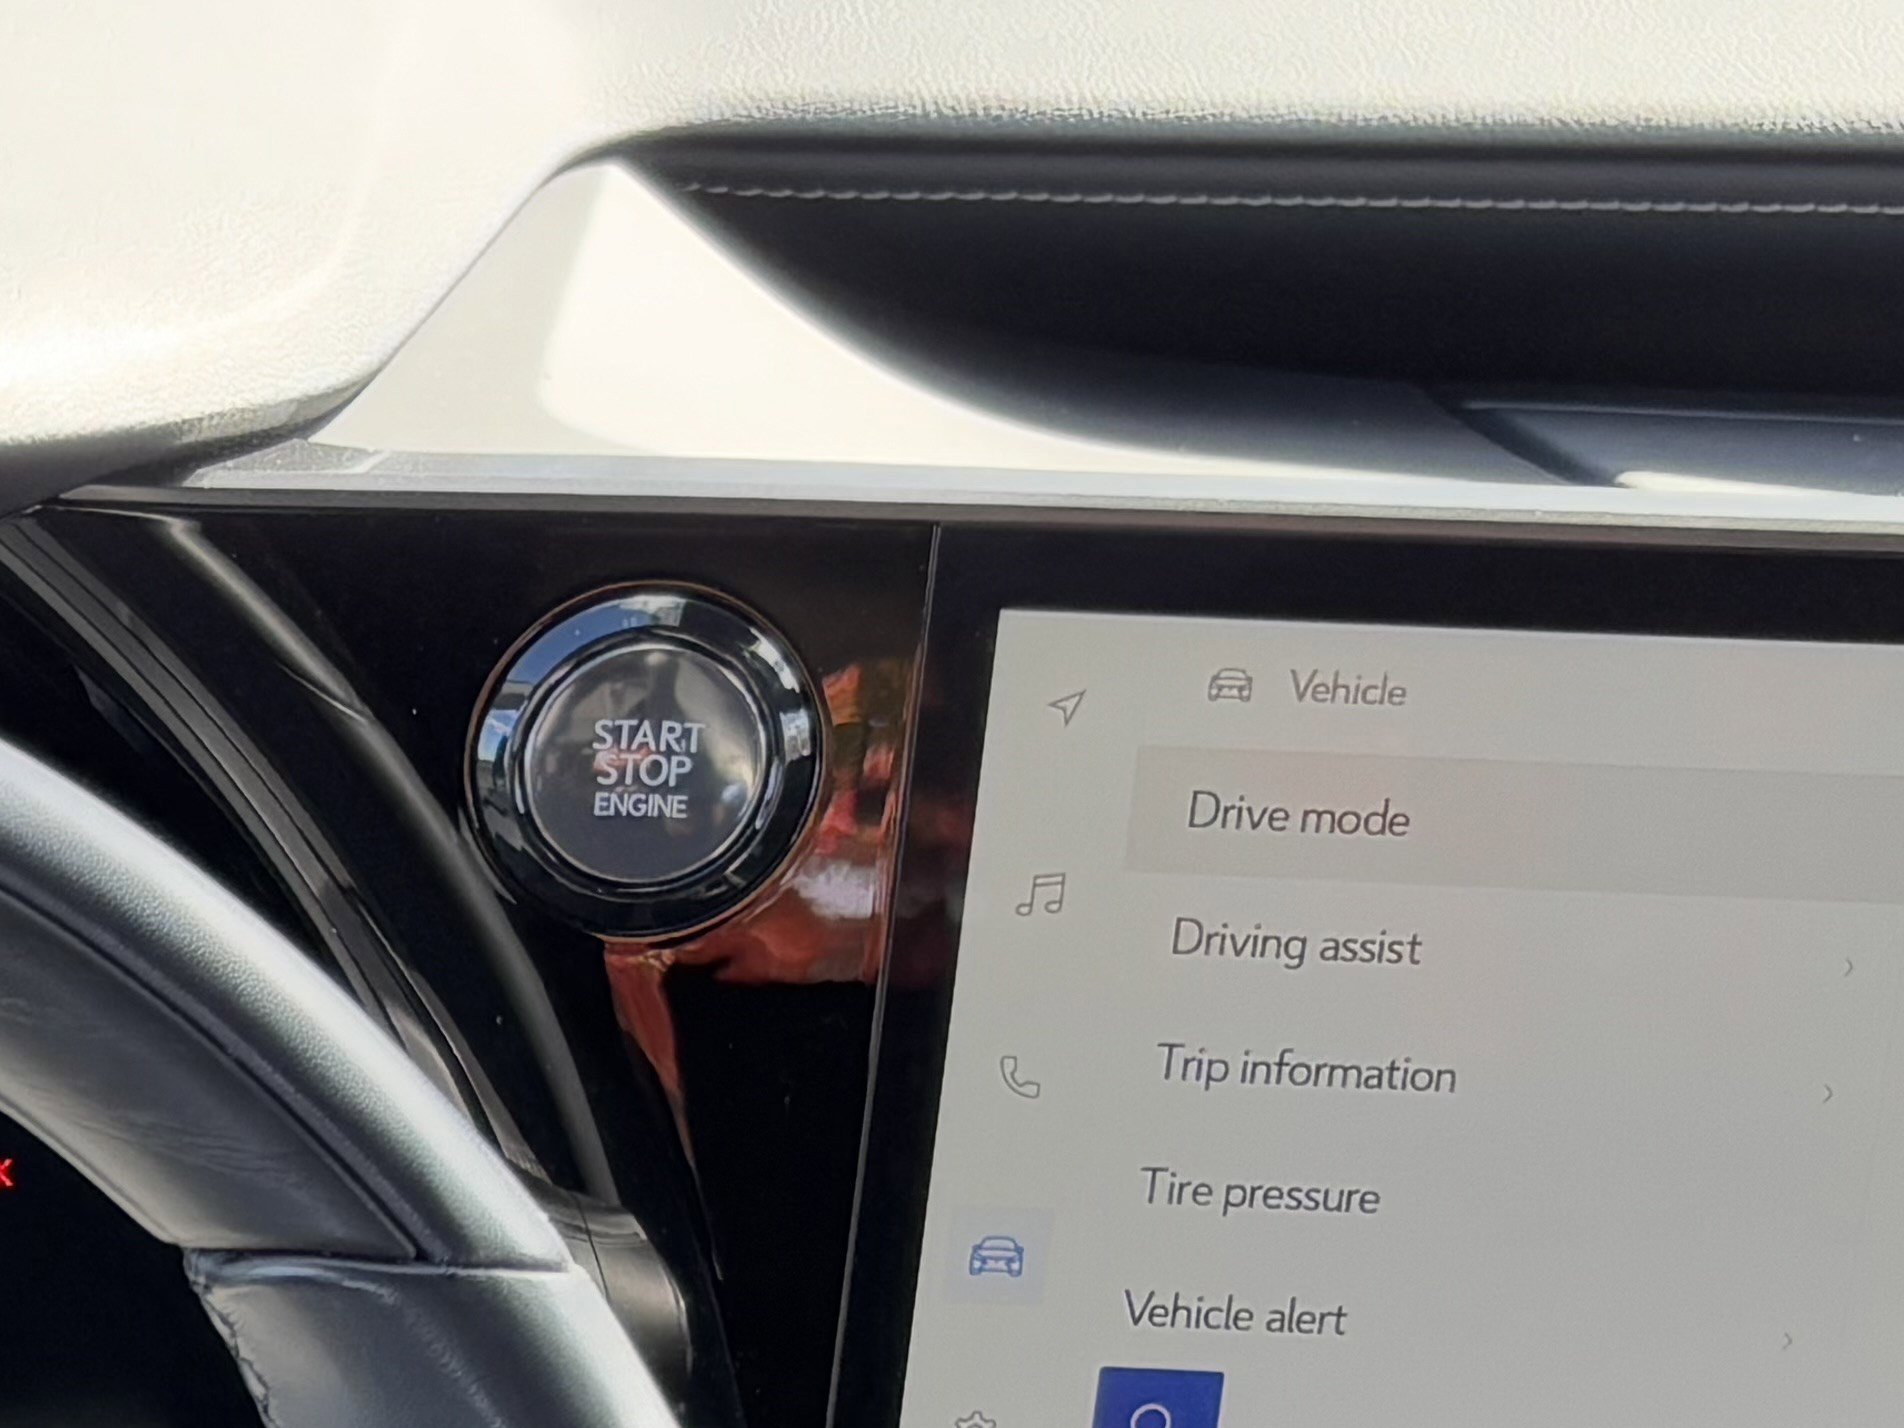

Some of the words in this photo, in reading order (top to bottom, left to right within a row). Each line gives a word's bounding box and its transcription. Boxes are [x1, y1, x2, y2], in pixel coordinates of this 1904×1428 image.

[1290, 668, 1407, 707] Vehicle
[593, 719, 705, 754] START
[595, 755, 693, 787] STOP
[593, 793, 689, 819] ENGINE
[1188, 790, 1290, 832] Drive
[1300, 797, 1411, 837] mode
[1172, 916, 1308, 970] Driving
[1319, 929, 1423, 966] assist
[1157, 1042, 1230, 1092] Trip
[1240, 1047, 1456, 1093] information
[1140, 1166, 1214, 1206] Tire
[1222, 1184, 1381, 1217] pressure
[1124, 1289, 1254, 1331] Vehicle
[1265, 1296, 1348, 1336] alert
